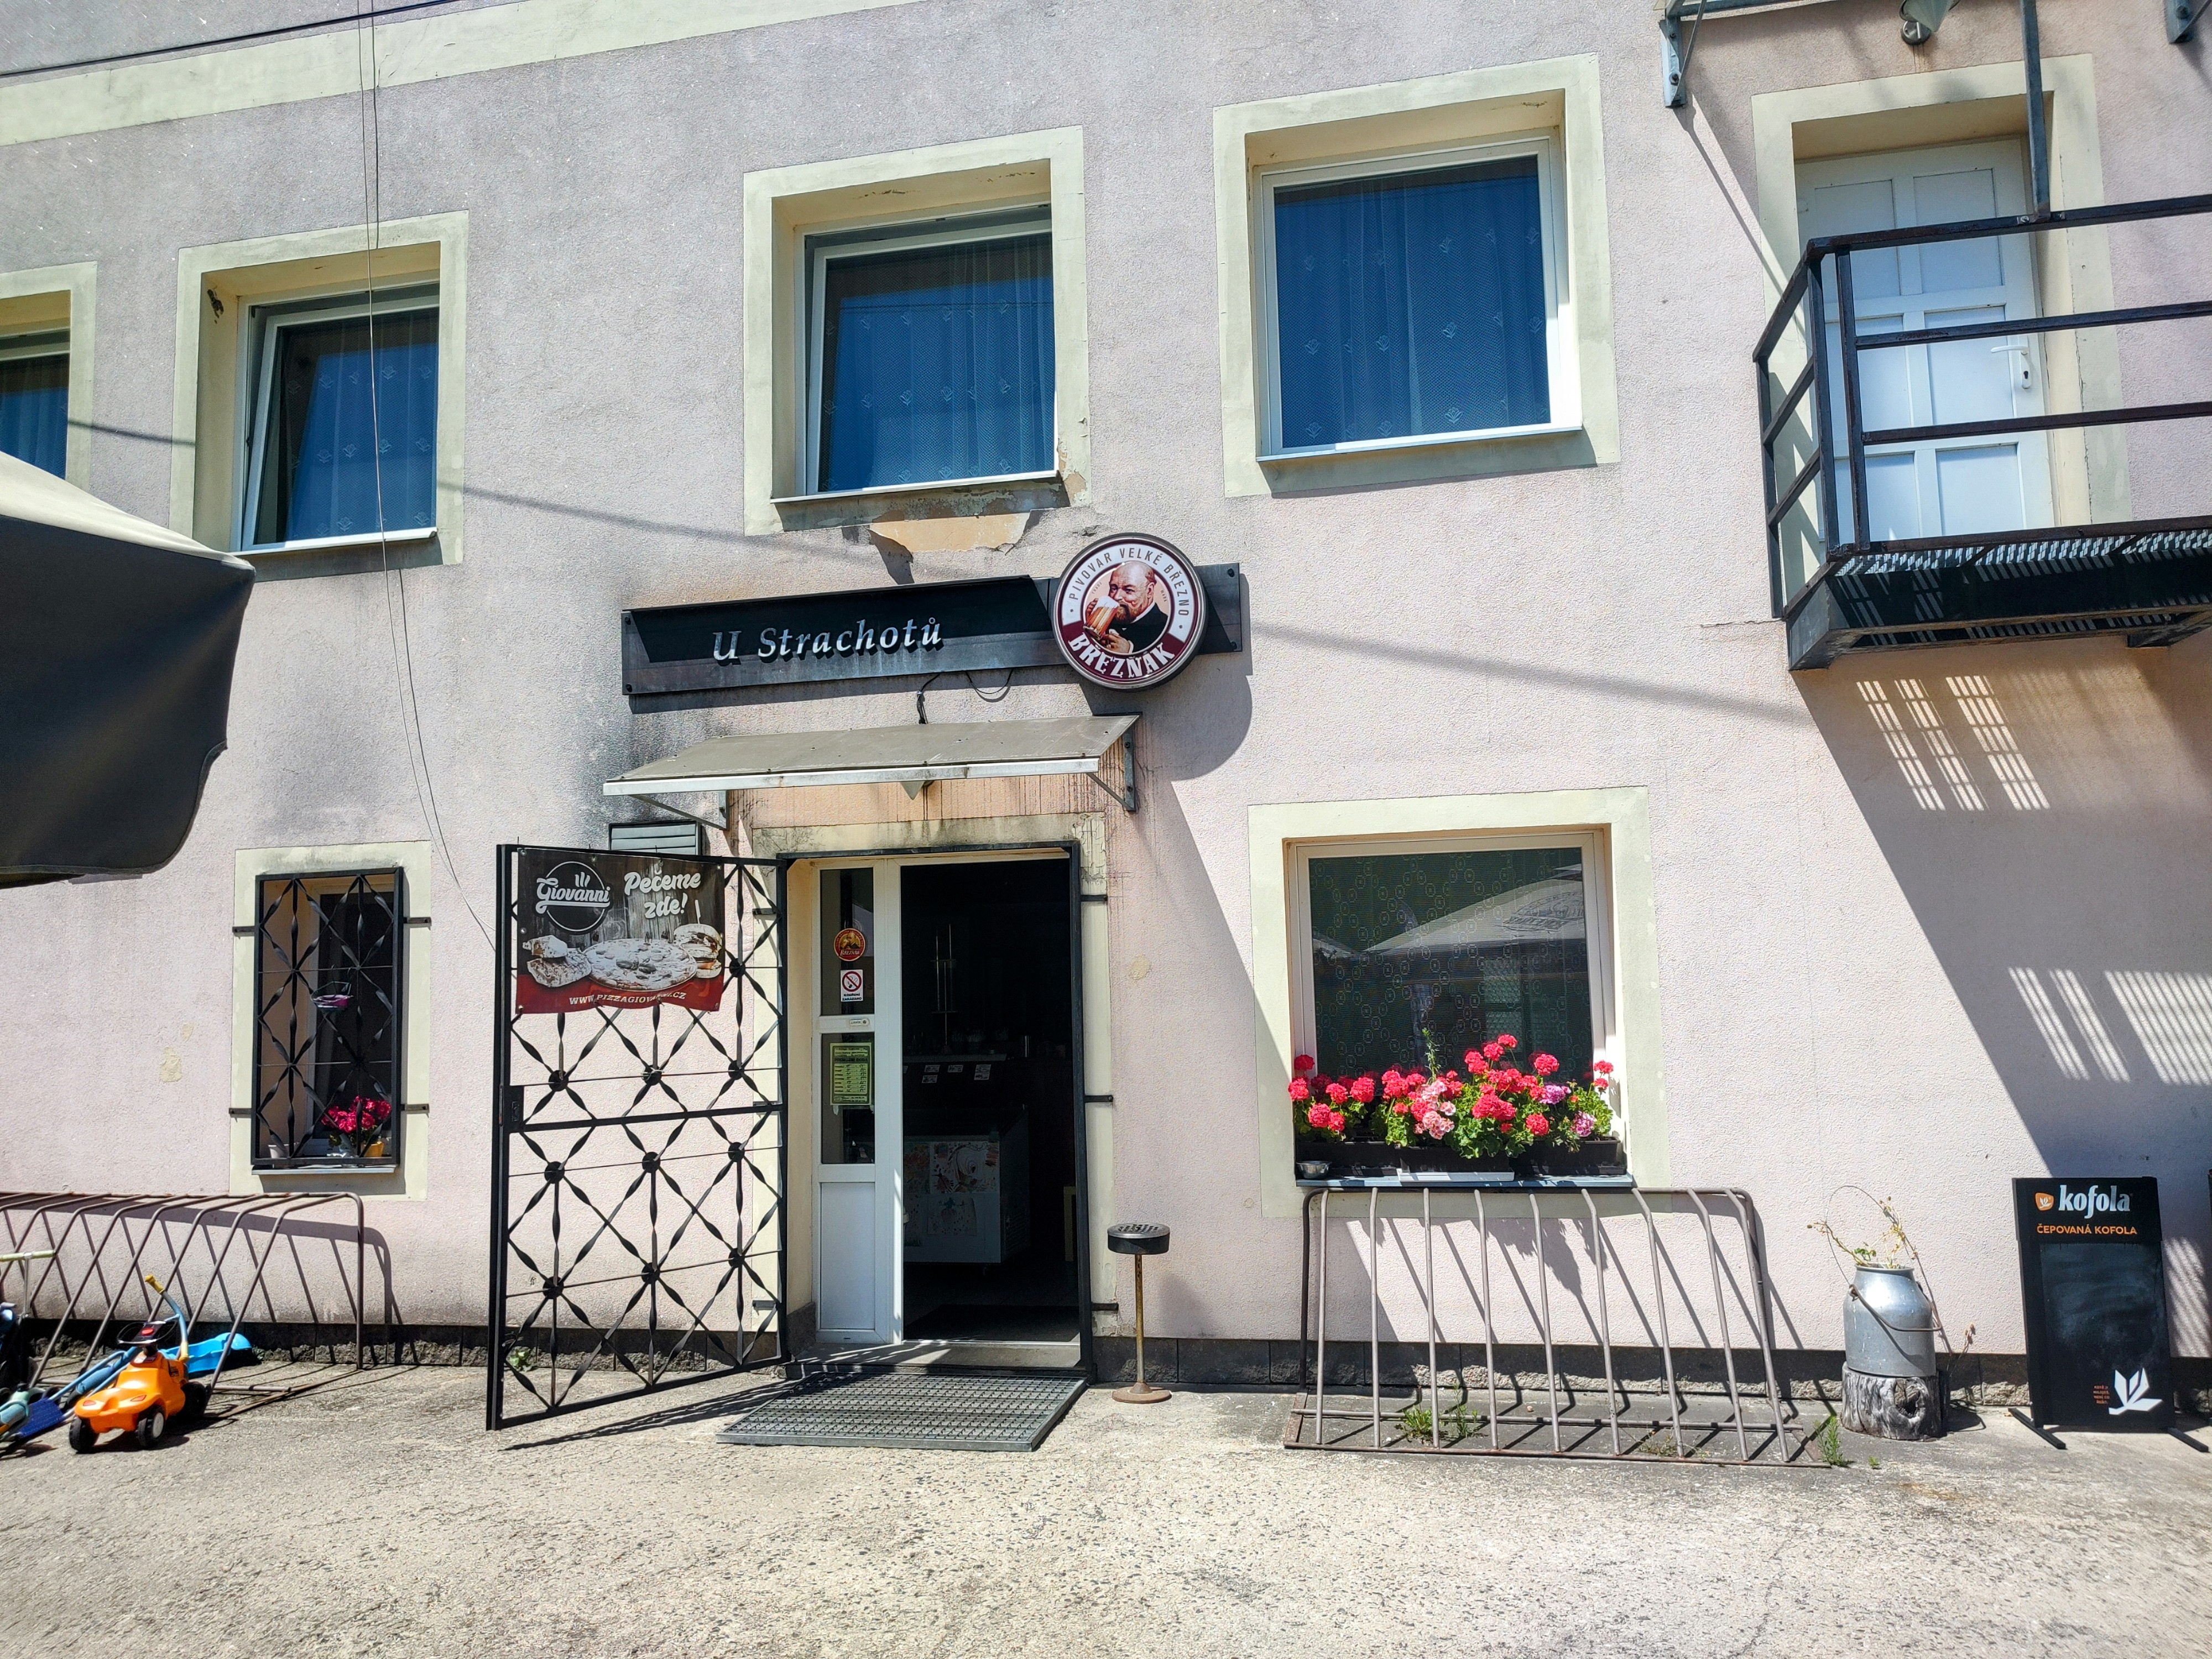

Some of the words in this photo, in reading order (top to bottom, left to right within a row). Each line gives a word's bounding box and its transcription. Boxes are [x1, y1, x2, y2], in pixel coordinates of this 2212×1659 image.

[1068, 552, 1112, 601] PIVOVAR
[1119, 547, 1164, 566] VELKÉ
[1163, 564, 1190, 616] BŘEZNO
[712, 630, 742, 660] U
[758, 617, 942, 657] Strachotů
[1068, 632, 1175, 679] BŘEZŇÁK
[535, 878, 611, 914] Giovanni
[624, 868, 701, 895] Pečeme
[644, 893, 688, 919] zde!
[2058, 1185, 2130, 1219] kofola
[2037, 1223, 2092, 1234] ČEPOVANÁ
[2094, 1225, 2138, 1235] KOFOLA
